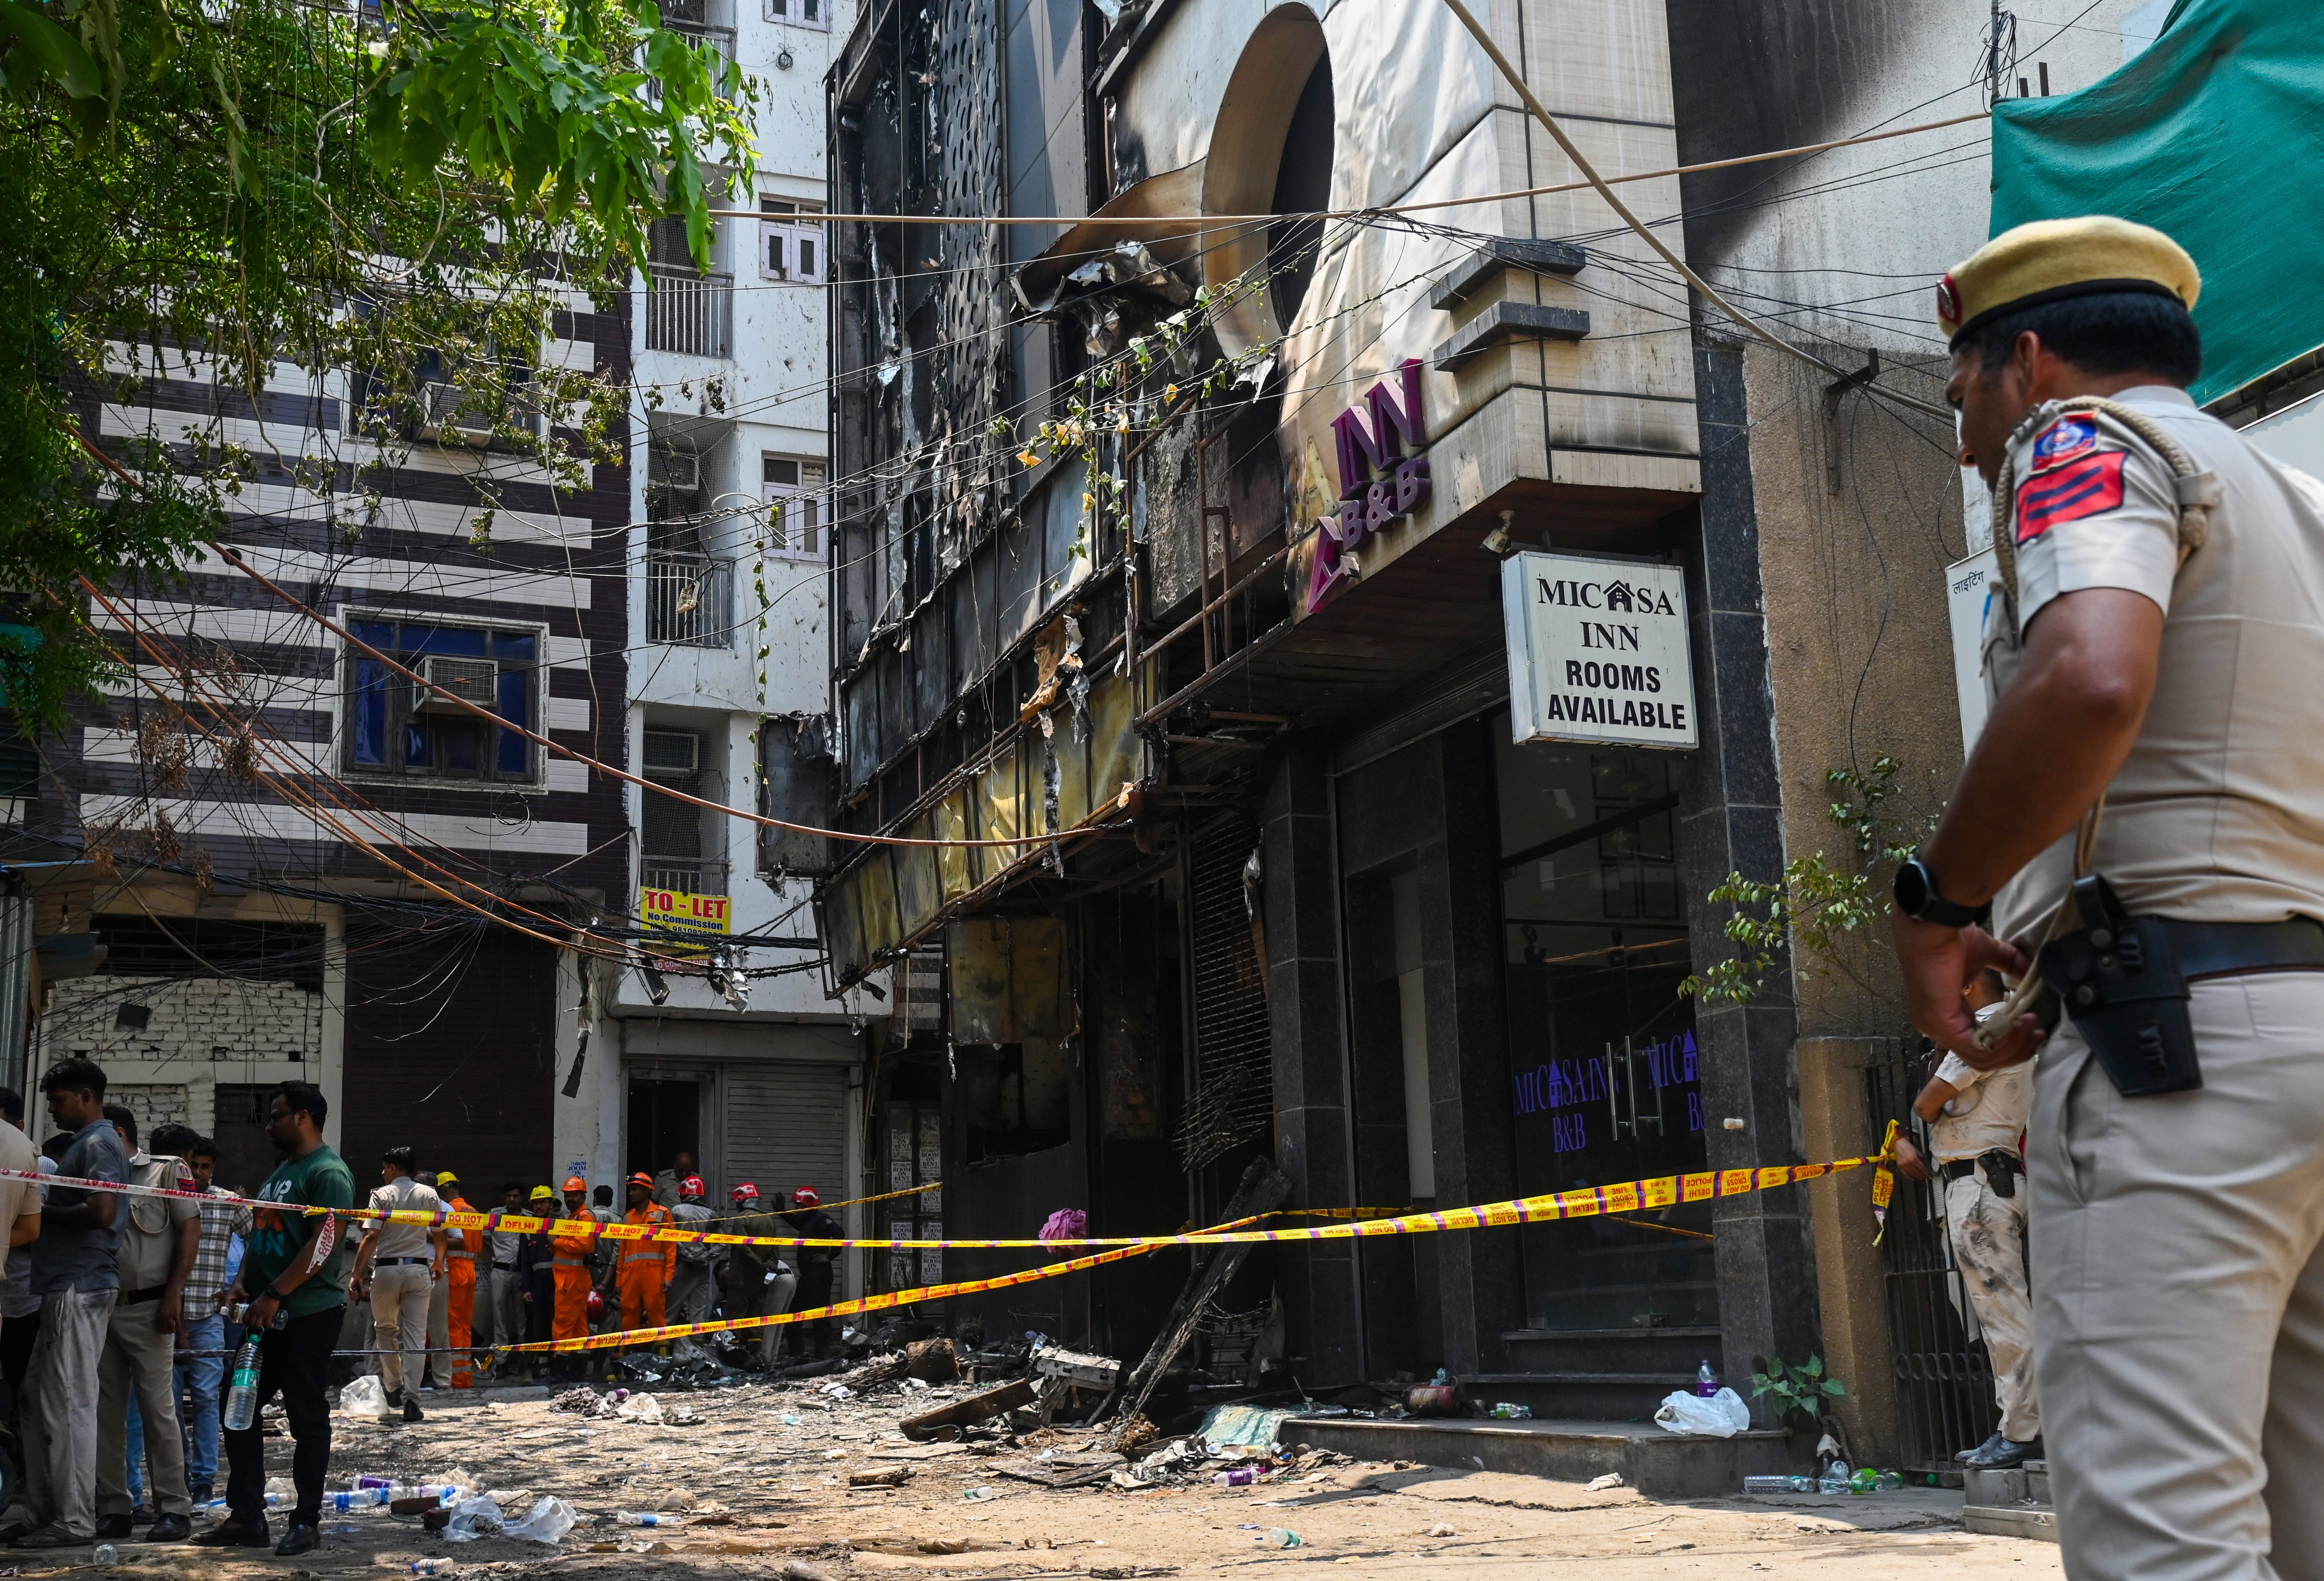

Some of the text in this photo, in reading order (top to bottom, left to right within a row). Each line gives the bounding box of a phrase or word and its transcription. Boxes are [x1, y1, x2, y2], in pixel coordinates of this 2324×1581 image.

[1331, 358, 1427, 500] INN
[1342, 458, 1431, 552] B&B
[1952, 570, 1984, 594] लाइटिंग
[1581, 622, 1639, 652] INN
[1566, 660, 1661, 694] ROOMS
[1548, 695, 1686, 730] AVAILABLE
[645, 890, 673, 912] TO
[692, 897, 727, 919] LET
[647, 912, 660, 920] No
[662, 914, 723, 930] Commission
[1552, 1114, 1586, 1153] B&B
[1686, 1177, 1712, 1187] POLICE
[1727, 1178, 1747, 1186] CROSS
[1801, 1169, 1823, 1178] DELHI
[1565, 1194, 1593, 1203] POLICE
[1611, 1194, 1633, 1202] CROSS
[1689, 1188, 1710, 1198] DELHI
[1873, 1192, 1879, 1202] DO
[1879, 1179, 1889, 1202] CROSS
[1573, 1203, 1595, 1213] DELHI
[505, 1221, 535, 1229] DELHI
